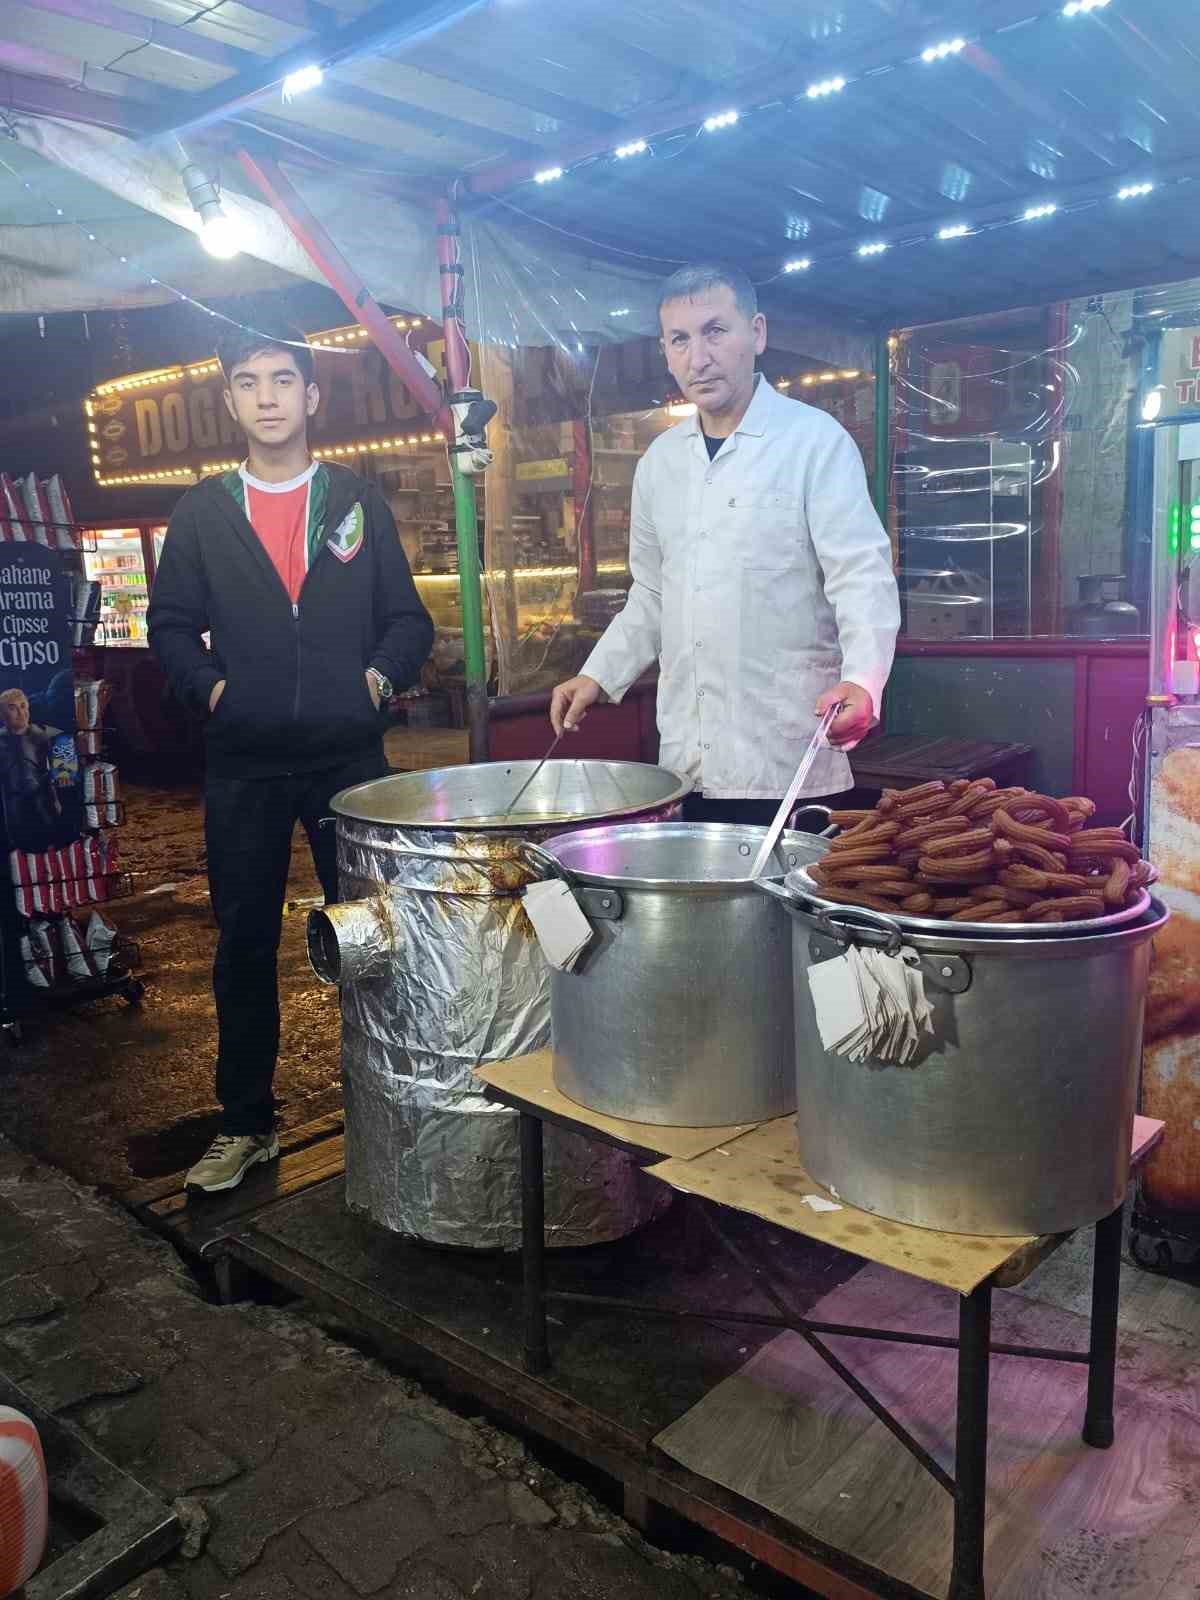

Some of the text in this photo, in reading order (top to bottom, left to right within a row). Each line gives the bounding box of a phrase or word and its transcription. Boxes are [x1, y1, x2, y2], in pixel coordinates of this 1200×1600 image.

[0, 564, 52, 586] ahane
[3, 614, 49, 637] Cipsse
[0, 636, 59, 670] Cipso
